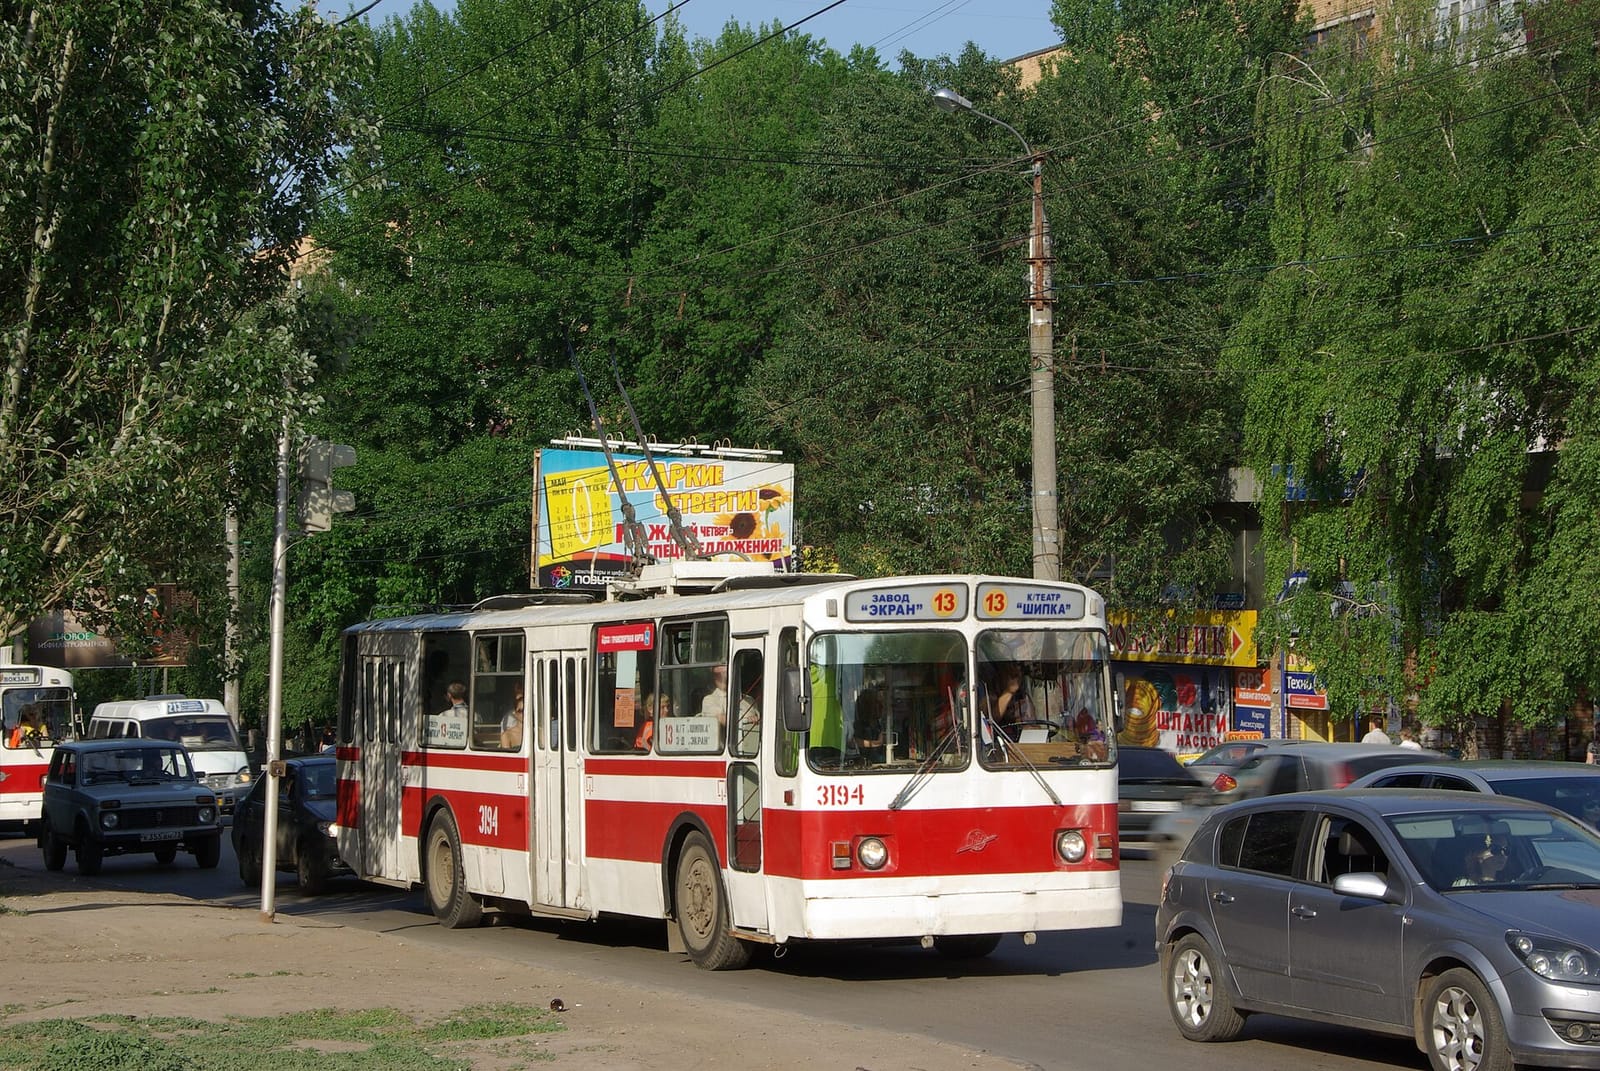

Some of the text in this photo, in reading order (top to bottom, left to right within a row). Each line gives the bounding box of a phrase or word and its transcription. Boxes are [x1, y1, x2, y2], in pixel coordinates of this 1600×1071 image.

[609, 461, 724, 492] ЖАРКИЕ
[656, 489, 757, 514] ЧЕТВЕРГИ!
[872, 594, 910, 603] ЗАВОД
[934, 592, 955, 612] 13
[985, 593, 1005, 612] 13
[1027, 593, 1061, 602] К/ТЕАТР
[861, 603, 923, 616] “ЭКРАН”
[1016, 602, 1071, 615] “ШИПКА”
[56, 632, 90, 641] НОВОЕ
[1238, 671, 1261, 690] GPS
[440, 723, 447, 738] 13
[1157, 711, 1227, 733] ШЛАНГИ
[665, 724, 673, 745] 13
[817, 784, 864, 806] 3194
[478, 805, 499, 837] 3194
